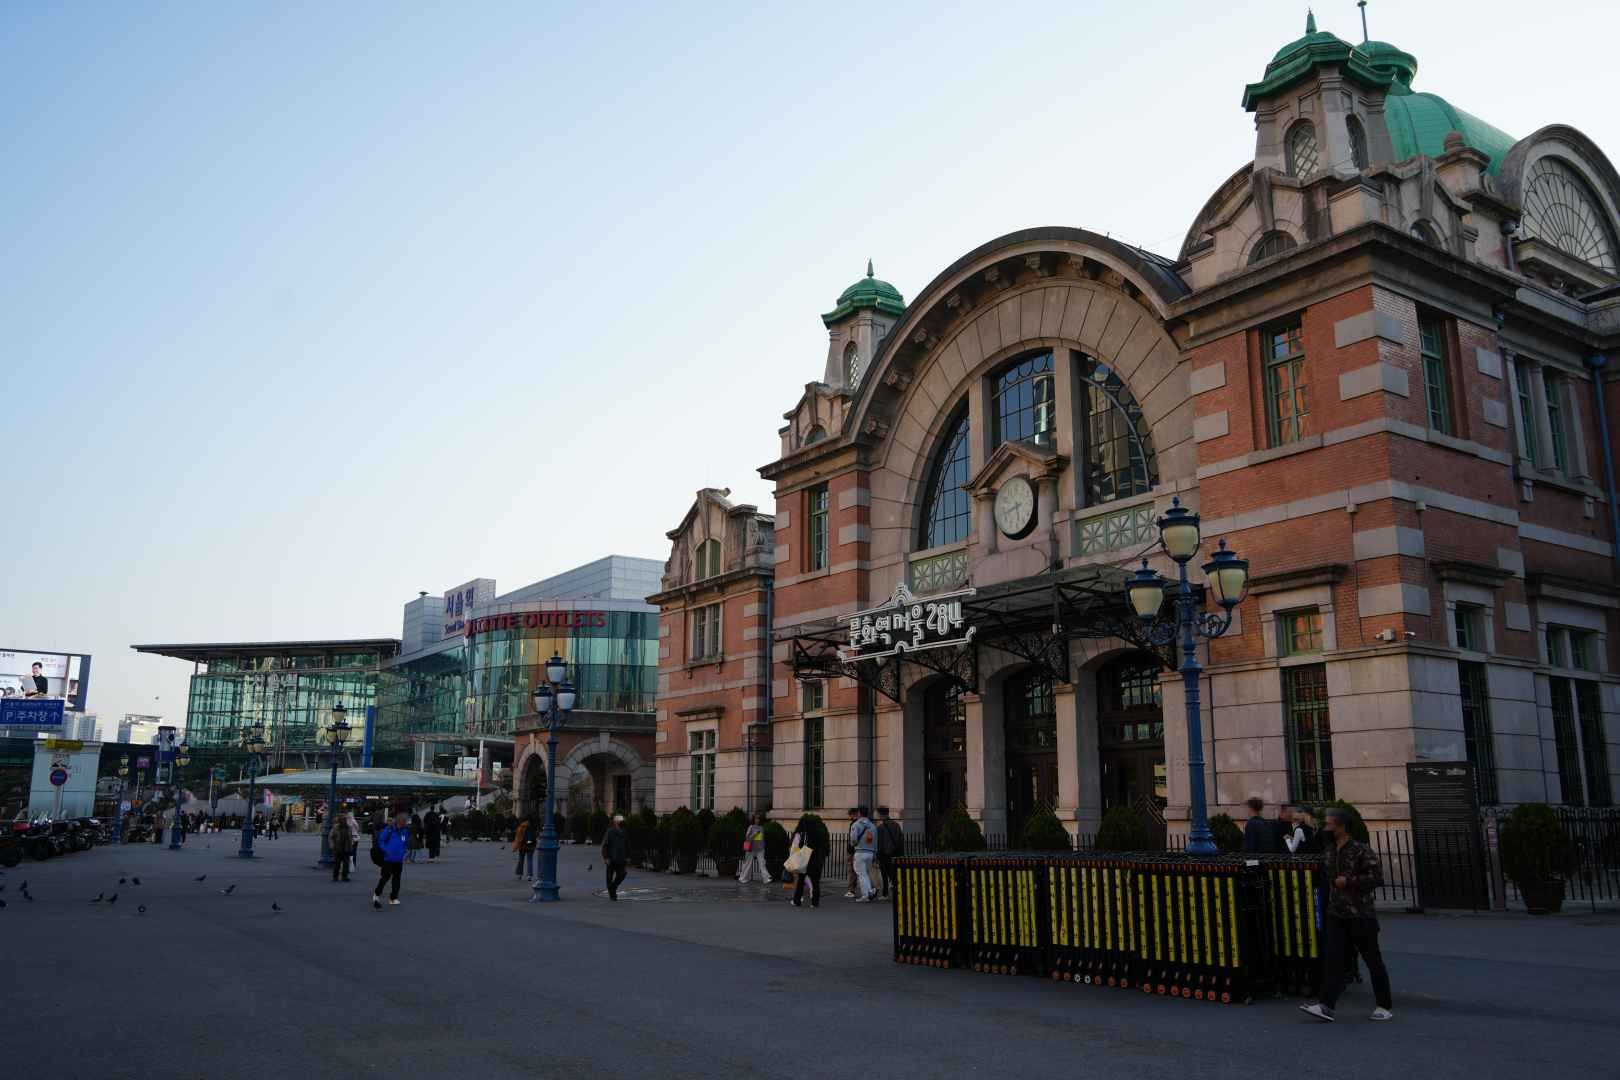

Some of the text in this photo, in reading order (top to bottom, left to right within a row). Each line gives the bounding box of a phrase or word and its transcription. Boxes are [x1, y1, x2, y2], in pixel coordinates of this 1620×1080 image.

[446, 586, 475, 618] 서울역
[472, 612, 519, 635] LOTTE
[523, 610, 608, 629] OUTLETS
[849, 600, 965, 650] 문화역서울284
[16, 710, 48, 722] 주차장
